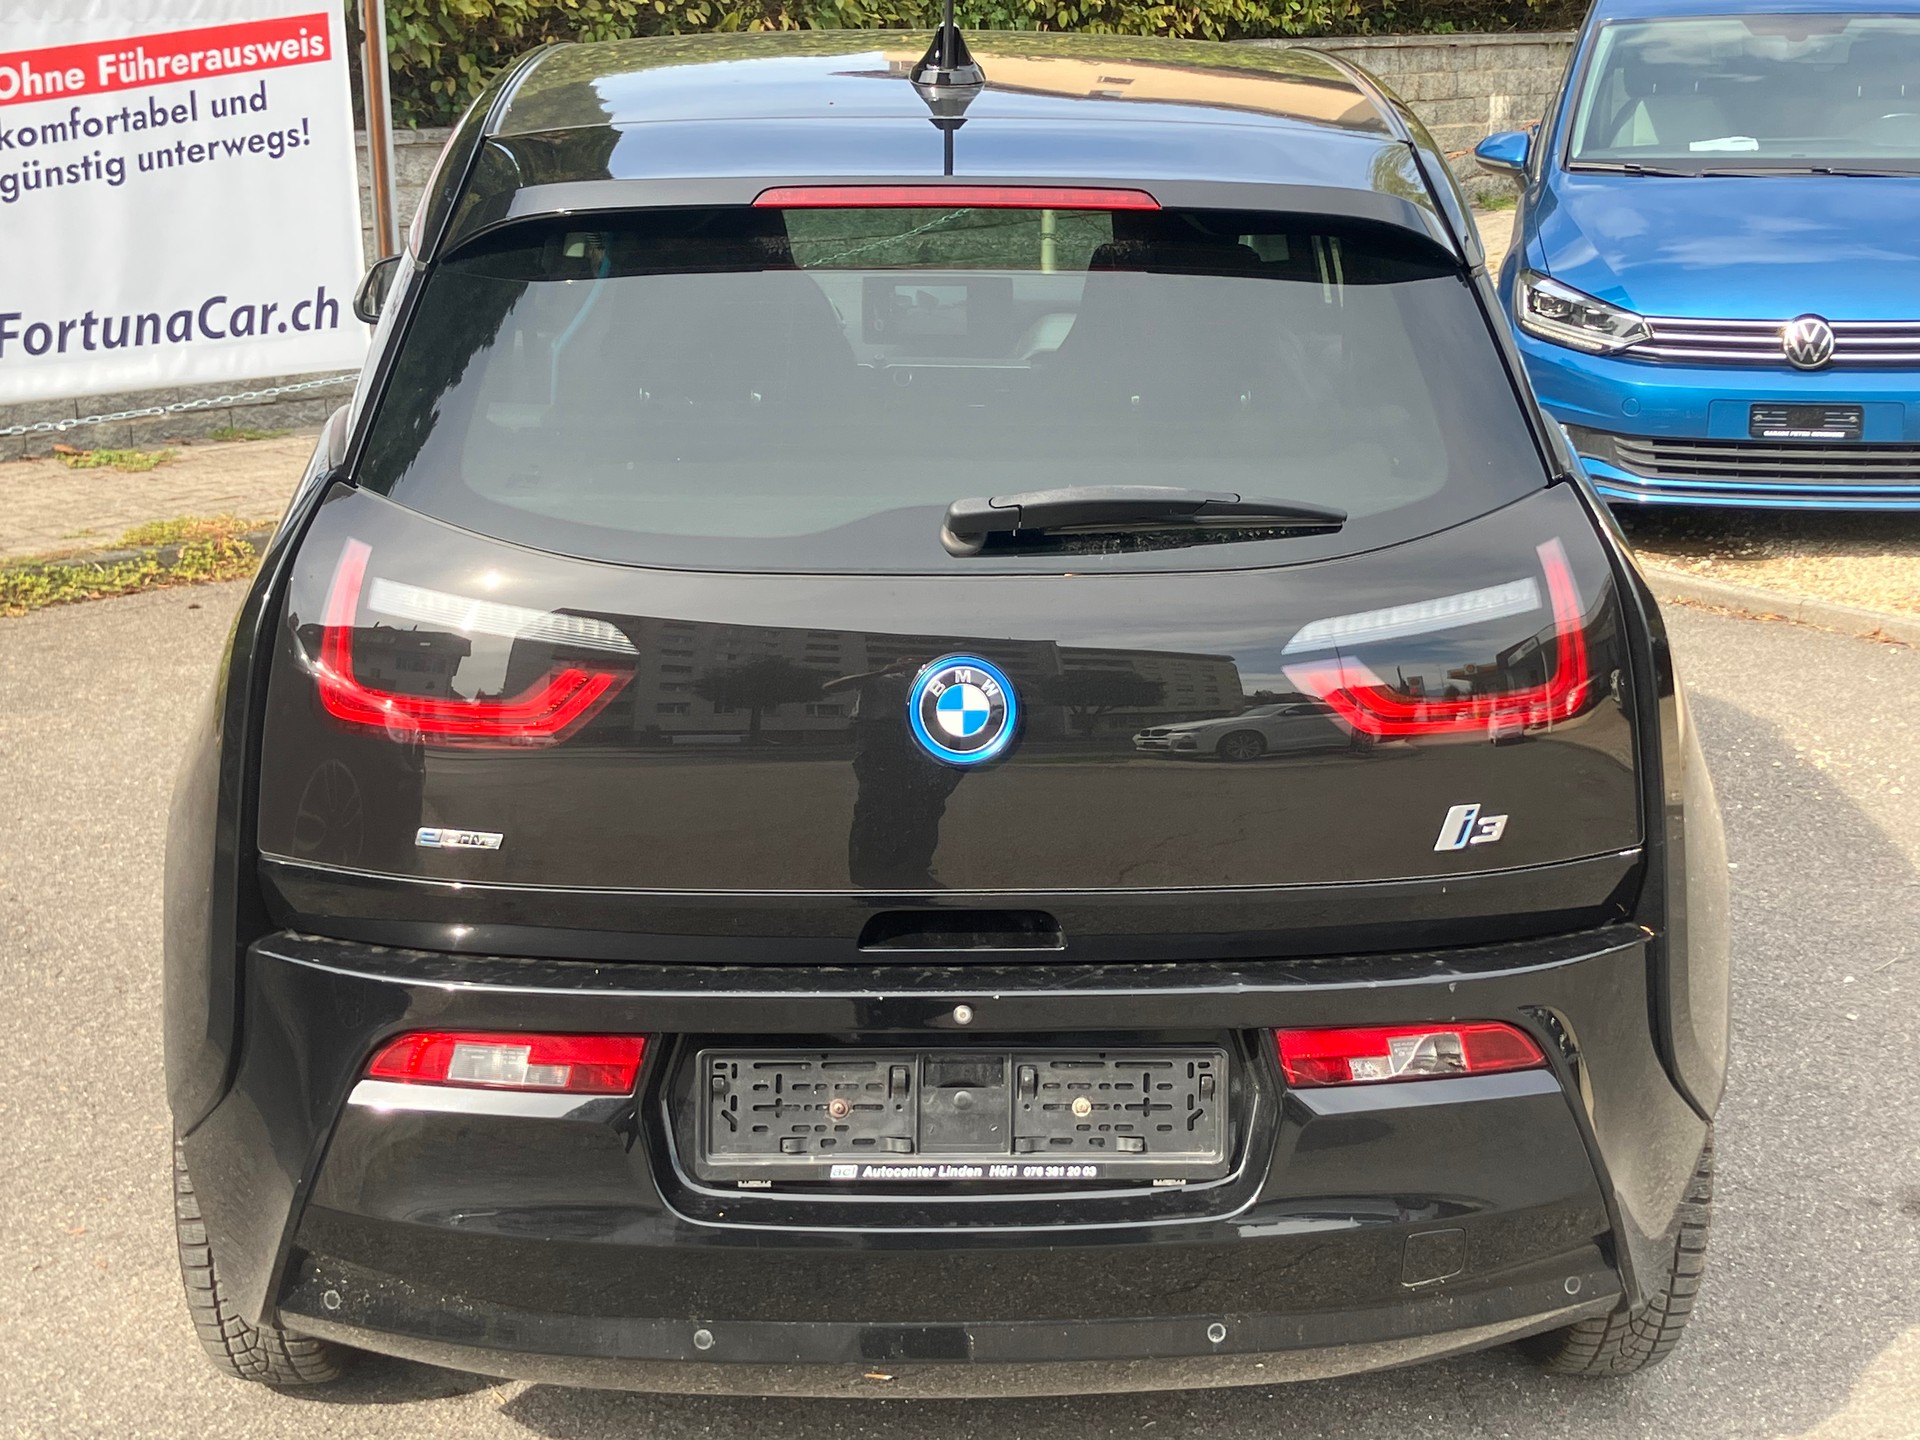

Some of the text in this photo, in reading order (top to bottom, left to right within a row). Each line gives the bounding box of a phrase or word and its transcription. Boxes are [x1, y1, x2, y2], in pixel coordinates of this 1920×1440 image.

[0, 28, 325, 100] Ohne Führerausweis
[0, 80, 268, 150] komfortabel und
[0, 118, 310, 203] günstig unterwegs!
[0, 286, 340, 358] FortunaCar.ch
[928, 669, 999, 698] BMW
[862, 1165, 937, 1178] Autocenter
[938, 1164, 983, 1177] Linden
